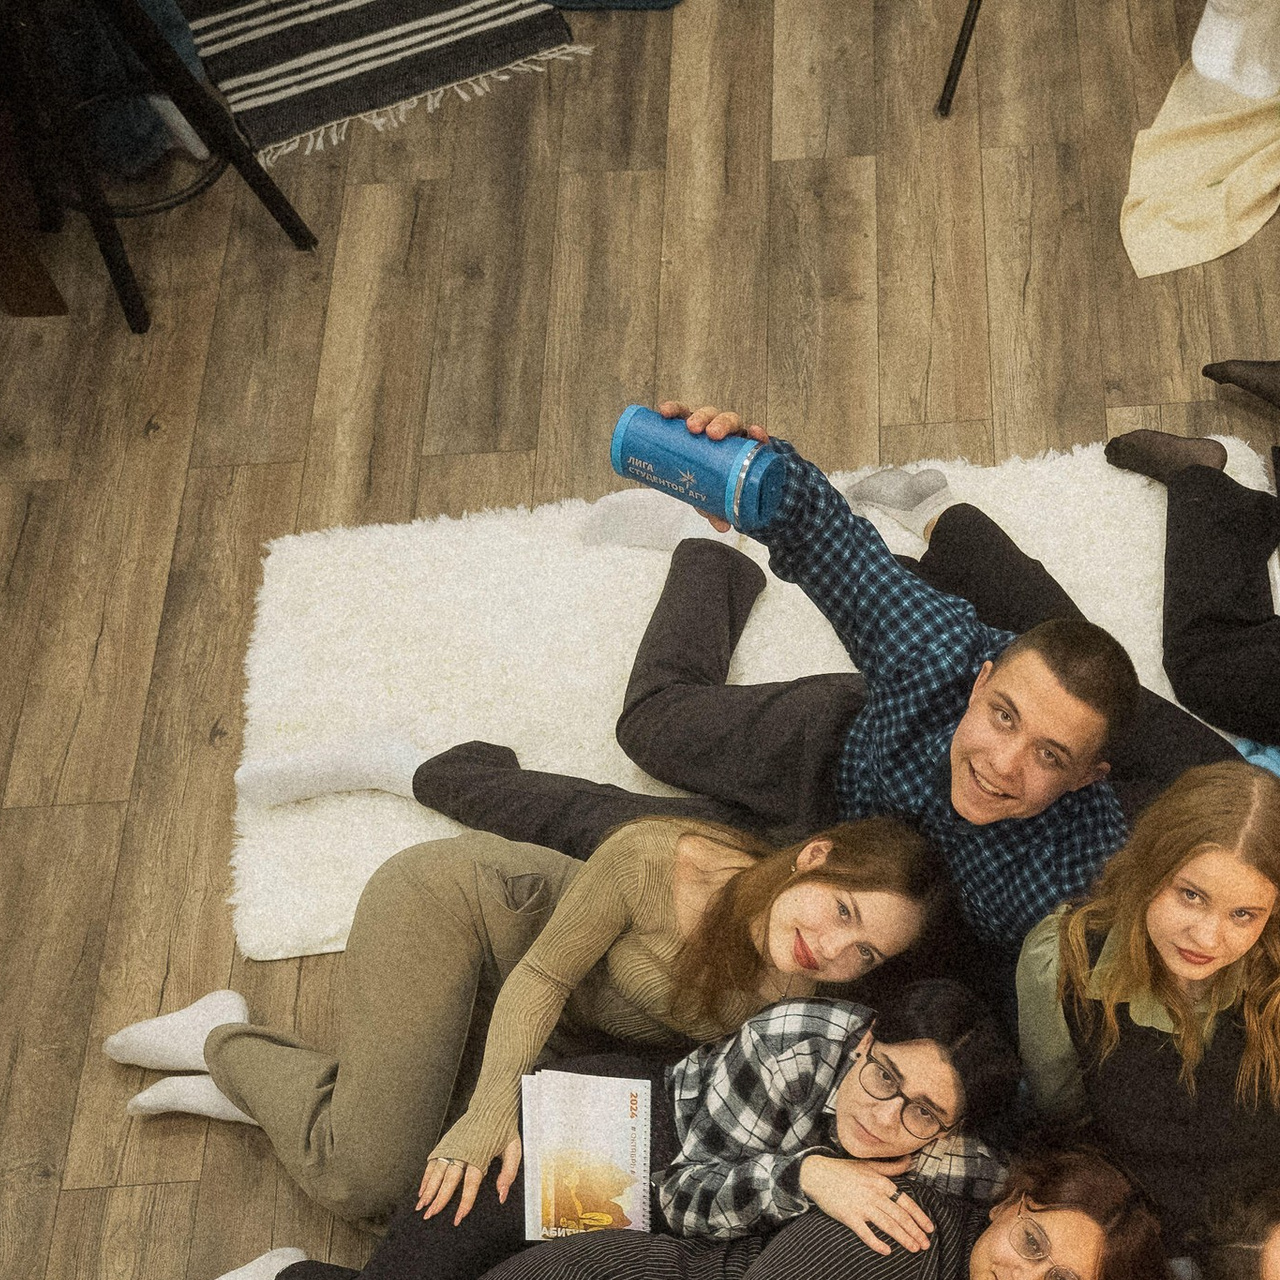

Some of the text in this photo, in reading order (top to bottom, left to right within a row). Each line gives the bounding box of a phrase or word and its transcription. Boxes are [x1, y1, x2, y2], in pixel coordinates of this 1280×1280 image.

[627, 456, 654, 473] ЛИГА
[628, 466, 707, 502] СТУДЕНТОВ АГУ
[630, 1092, 638, 1119] 2024
